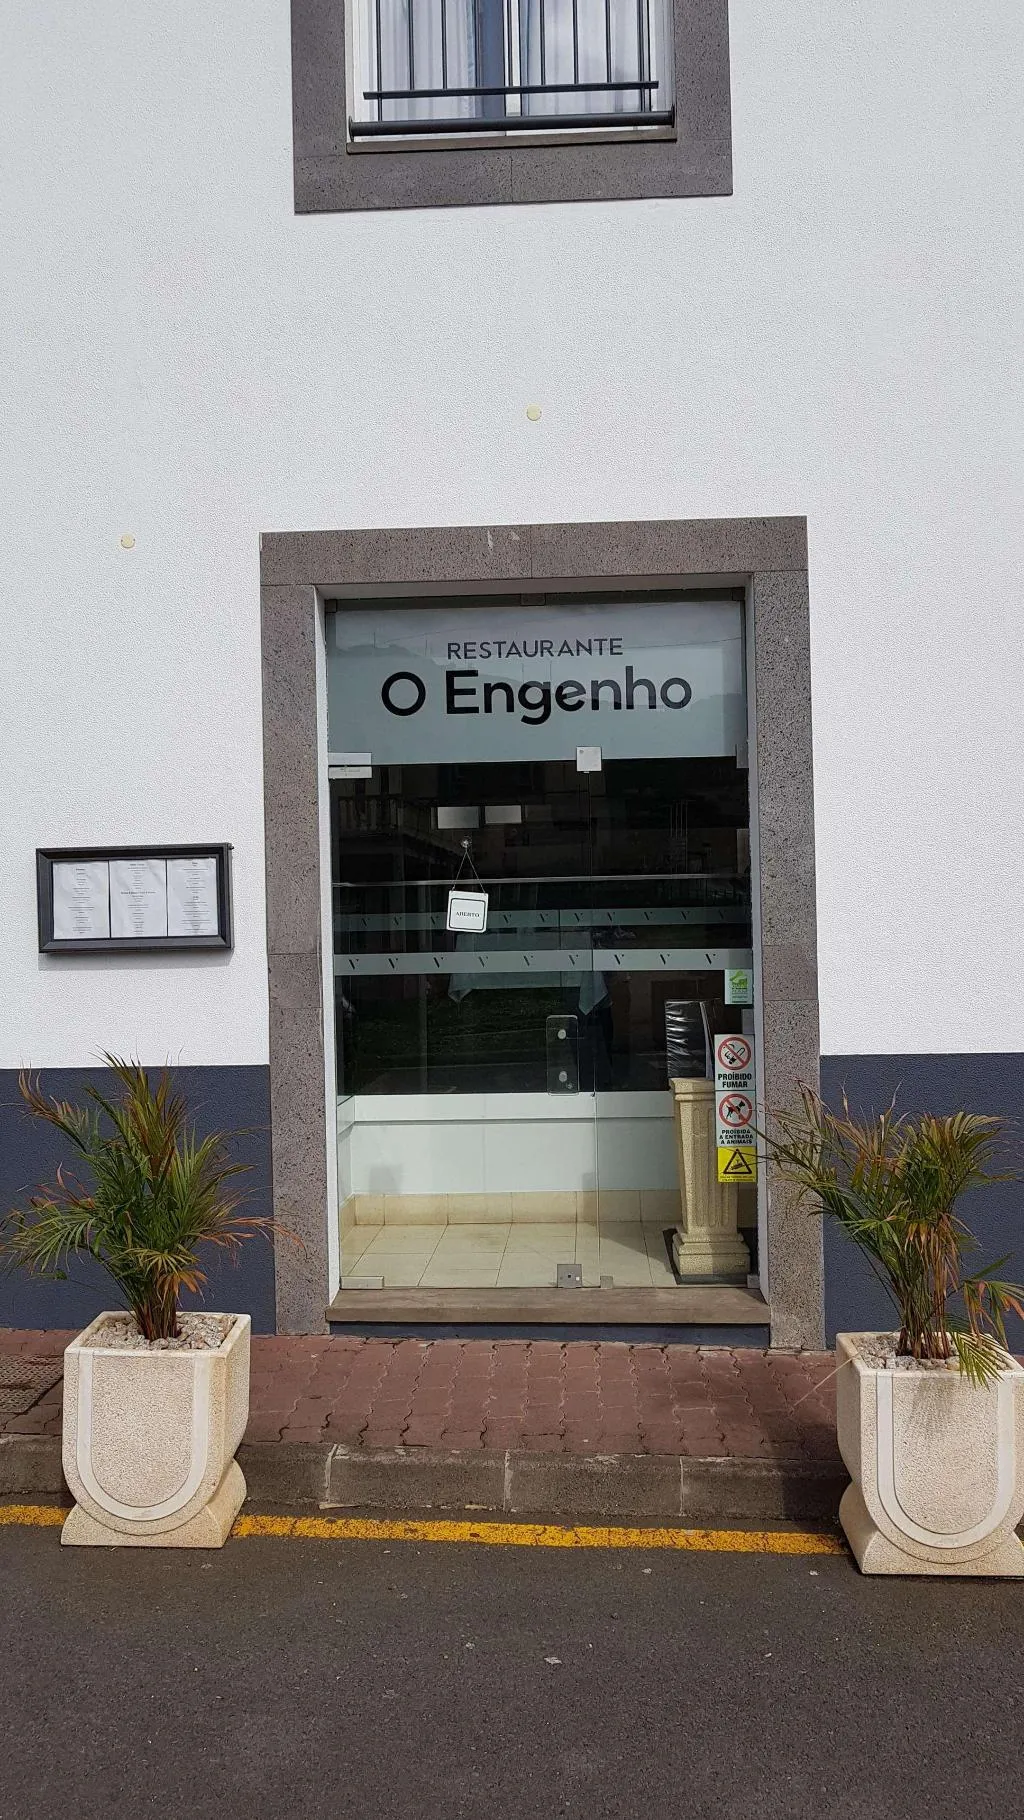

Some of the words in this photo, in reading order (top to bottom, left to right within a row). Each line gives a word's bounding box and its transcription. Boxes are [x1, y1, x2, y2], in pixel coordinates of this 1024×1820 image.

[447, 638, 624, 660] RESTAURANTE
[381, 671, 426, 716] O
[446, 665, 692, 725] Engenho
[722, 1080, 748, 1088] FUMAR
